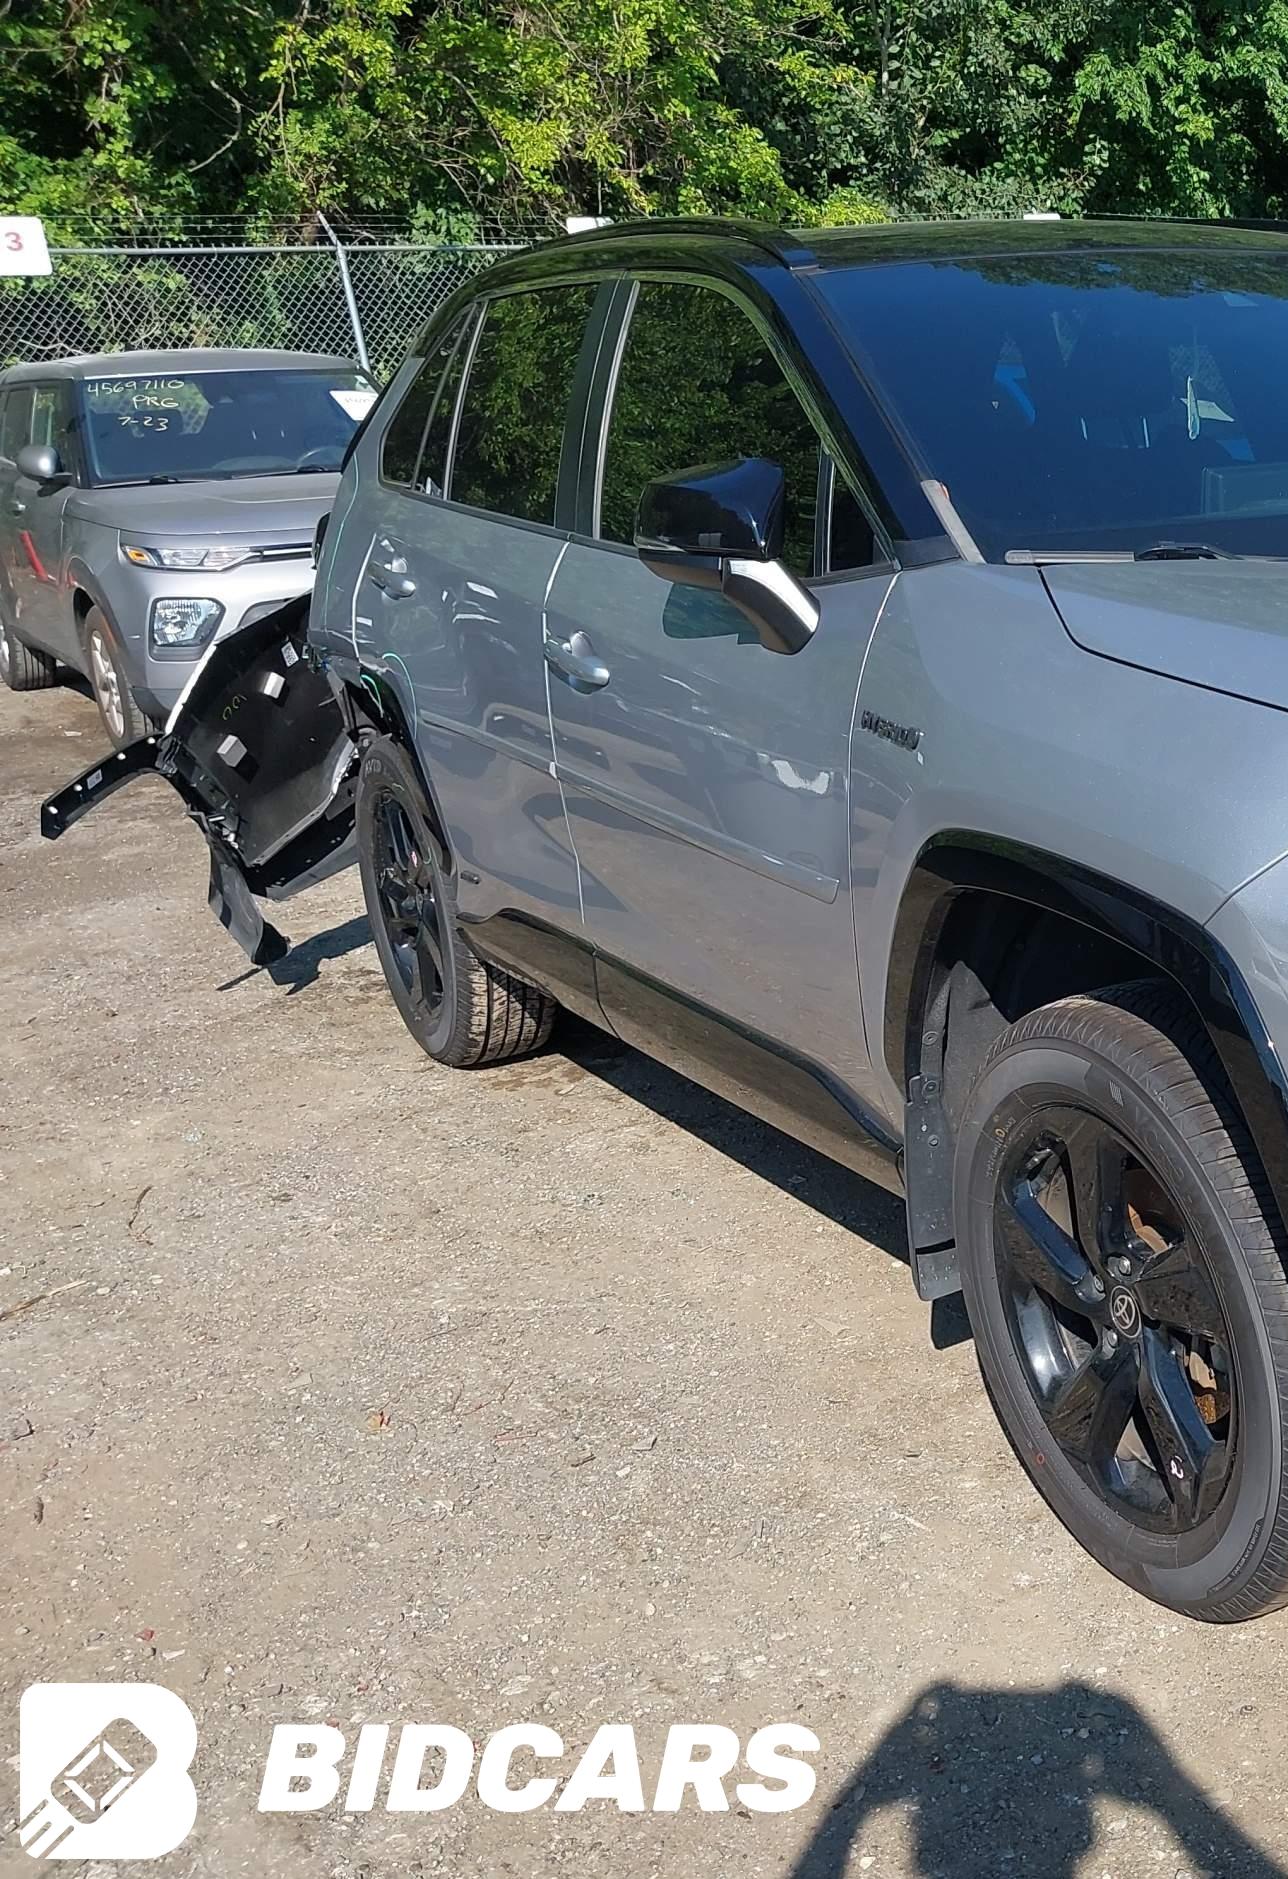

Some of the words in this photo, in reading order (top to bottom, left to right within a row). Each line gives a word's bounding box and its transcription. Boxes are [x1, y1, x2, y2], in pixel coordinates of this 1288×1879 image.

[4, 231, 24, 252] 3
[87, 379, 185, 397] 45697110
[132, 394, 179, 410] PRG
